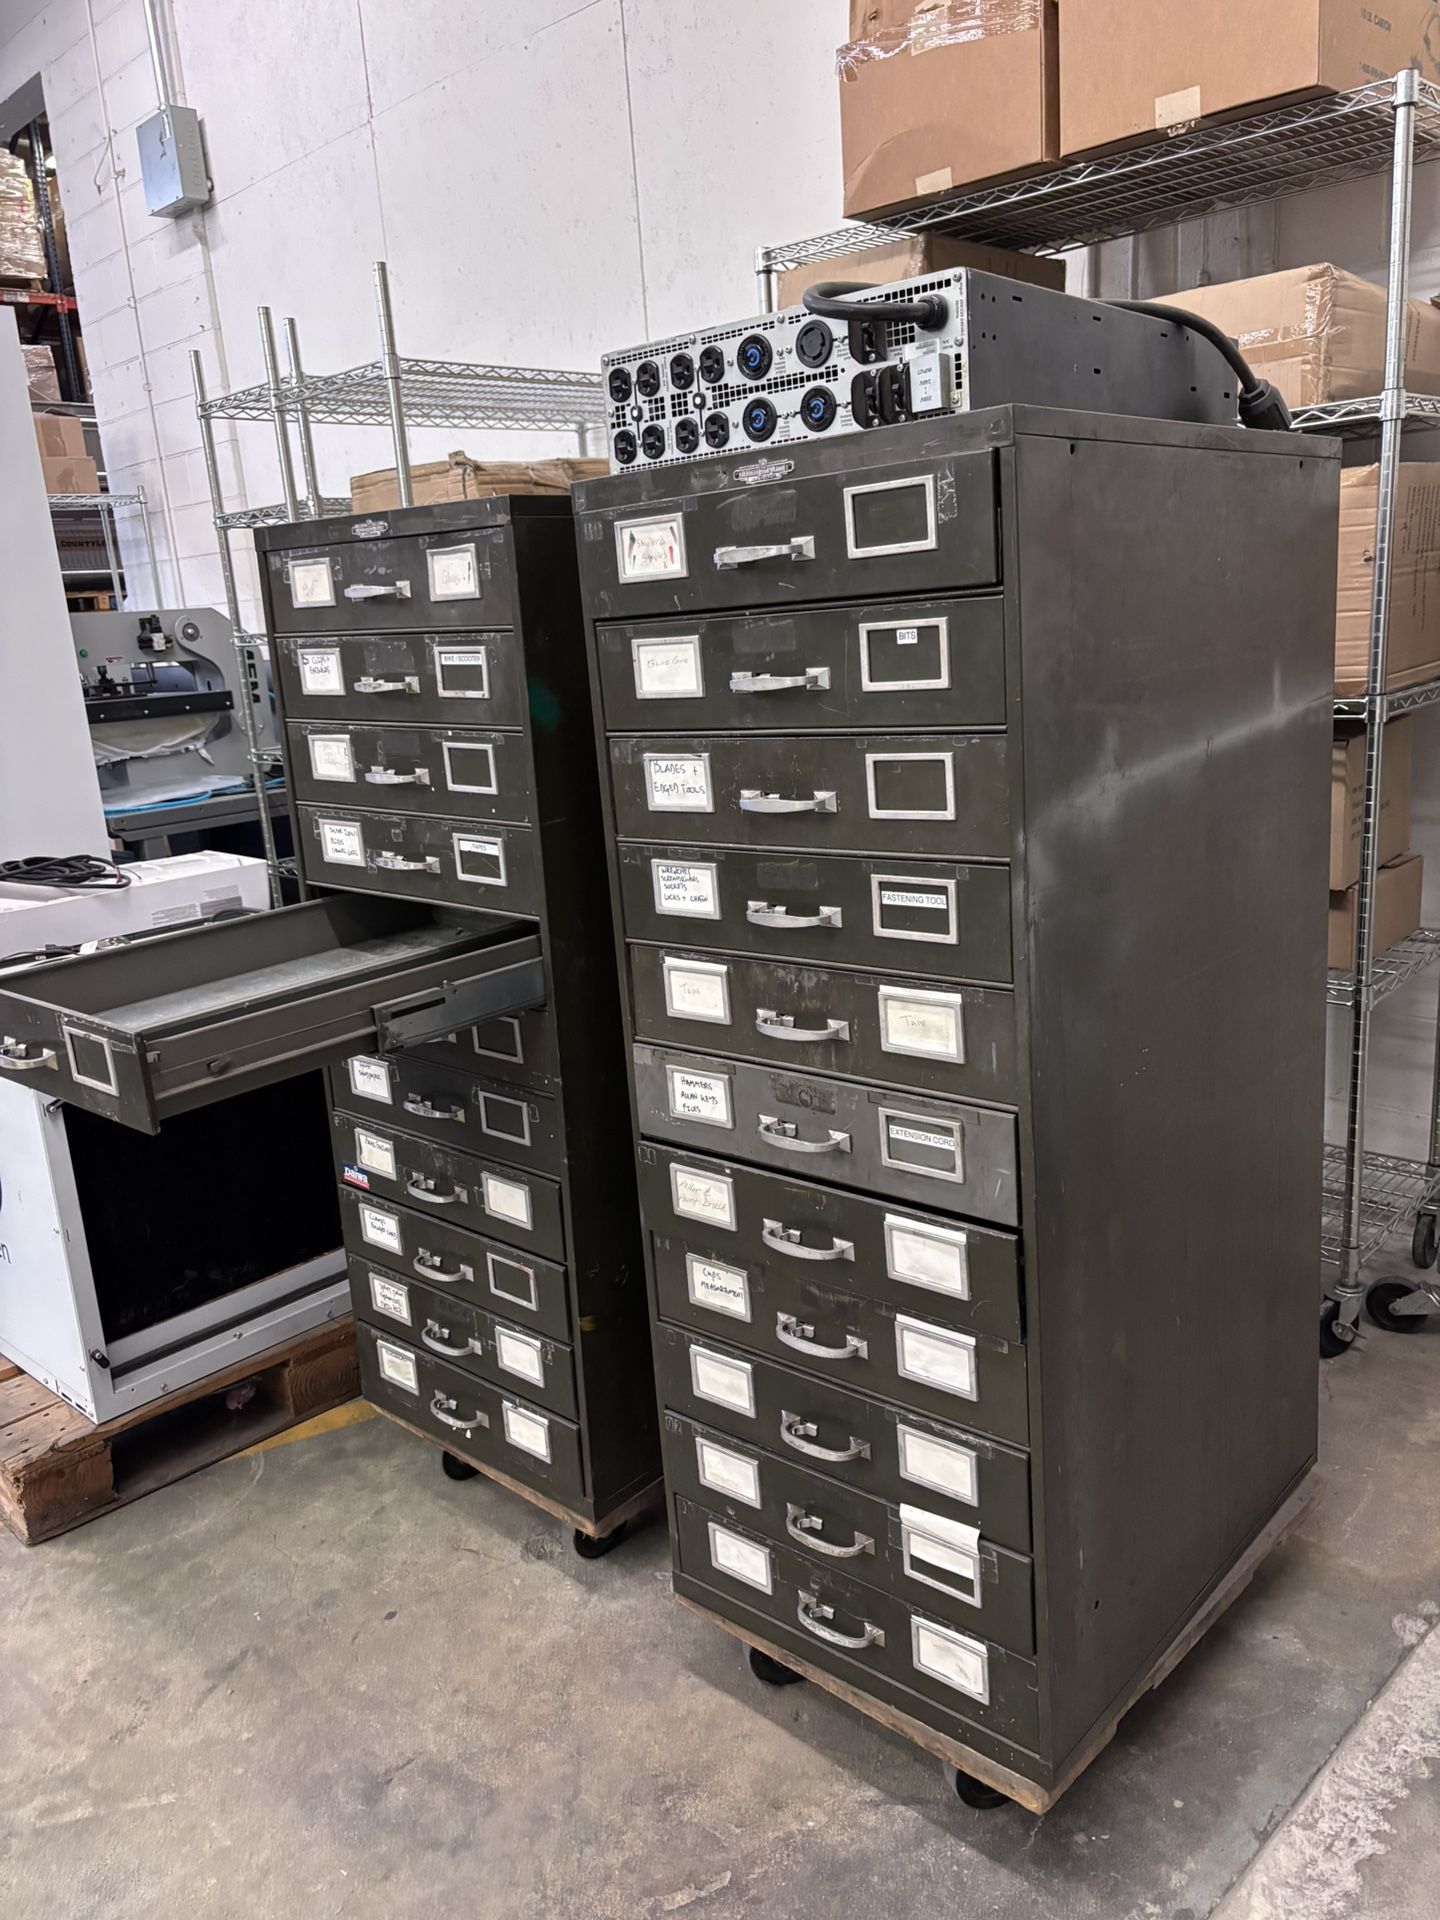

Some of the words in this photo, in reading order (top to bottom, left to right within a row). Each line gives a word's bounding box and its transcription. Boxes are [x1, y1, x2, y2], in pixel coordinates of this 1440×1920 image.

[898, 630, 916, 641] BITS
[443, 655, 455, 663] BIKE
[458, 655, 481, 663] SCOOTER
[653, 760, 687, 775] BLADES
[653, 782, 680, 796] EDGED
[680, 783, 706, 795] TOOLS
[664, 893, 681, 901] LOCKS
[690, 893, 709, 903] CHAIN
[882, 893, 925, 904] FASTENING
[926, 896, 946, 906] TOOL
[681, 1076, 713, 1091] HAMMERS
[890, 1127, 932, 1143] EXTENSION
[932, 1135, 956, 1148] CORD
